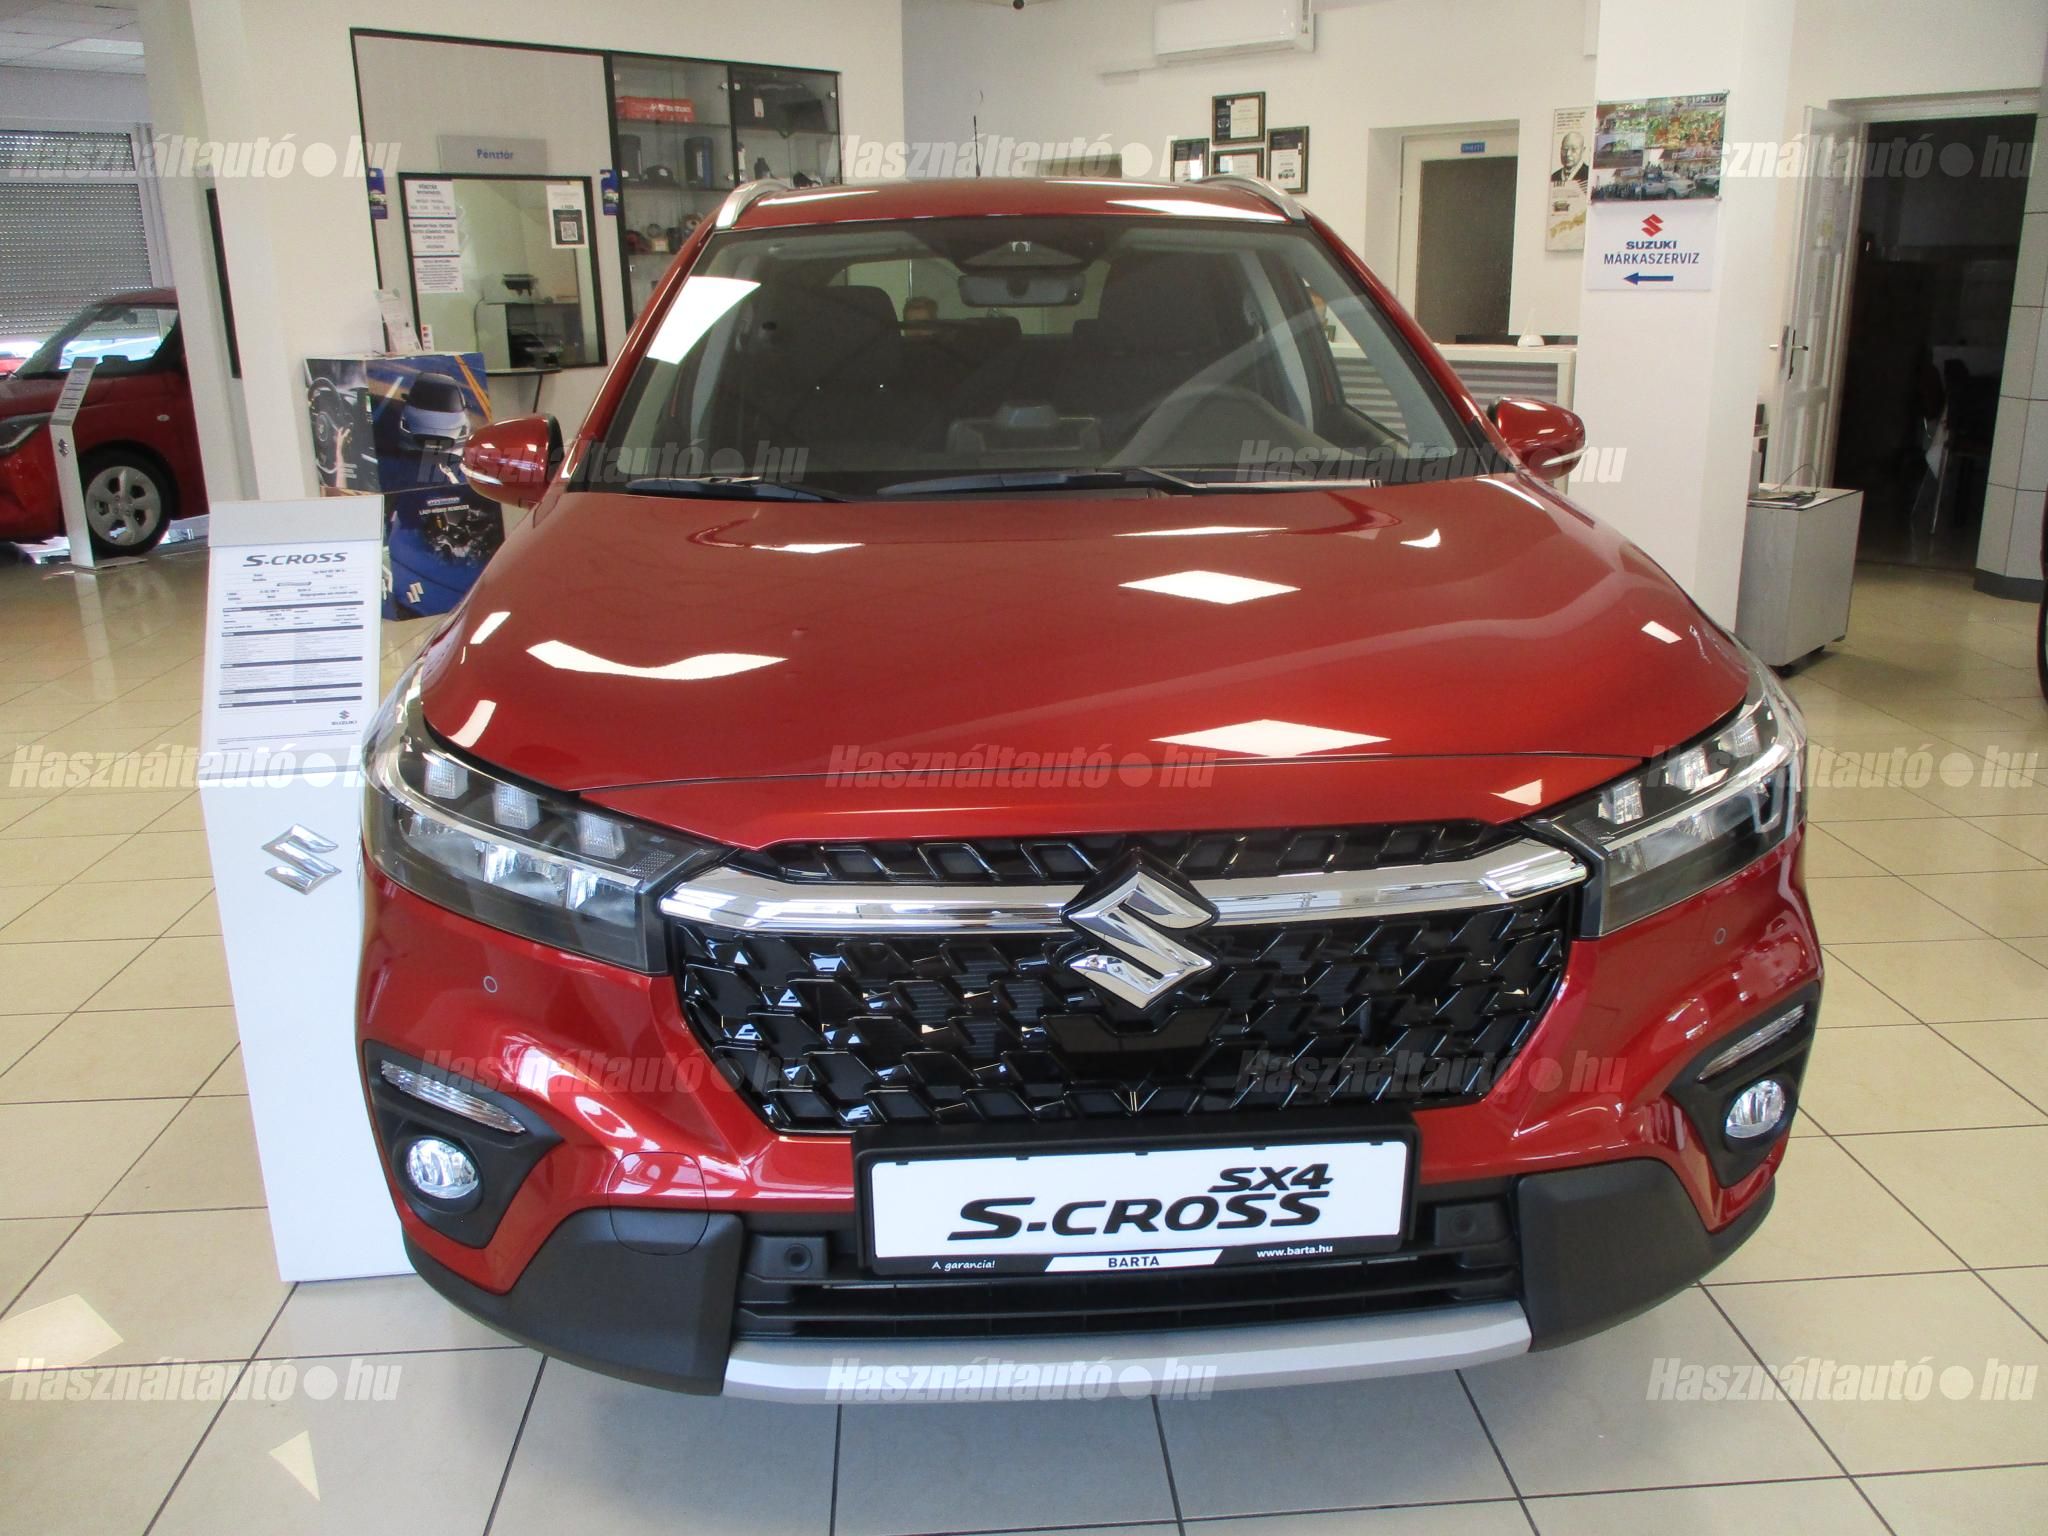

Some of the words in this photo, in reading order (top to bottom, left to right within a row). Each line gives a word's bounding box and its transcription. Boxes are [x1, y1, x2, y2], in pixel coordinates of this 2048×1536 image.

[1625, 240, 1677, 250] SUZUKI
[1603, 252, 1700, 265] MÁRKASZERVIZ
[242, 552, 348, 567] S-CROSS
[1208, 1163, 1333, 1193] SX4
[946, 1191, 1330, 1241] S-CROSS
[1256, 1244, 1334, 1259] www.barta.hu
[931, 1260, 942, 1270] A
[944, 1259, 996, 1272] garancia!
[1108, 1256, 1160, 1269] BARTA
